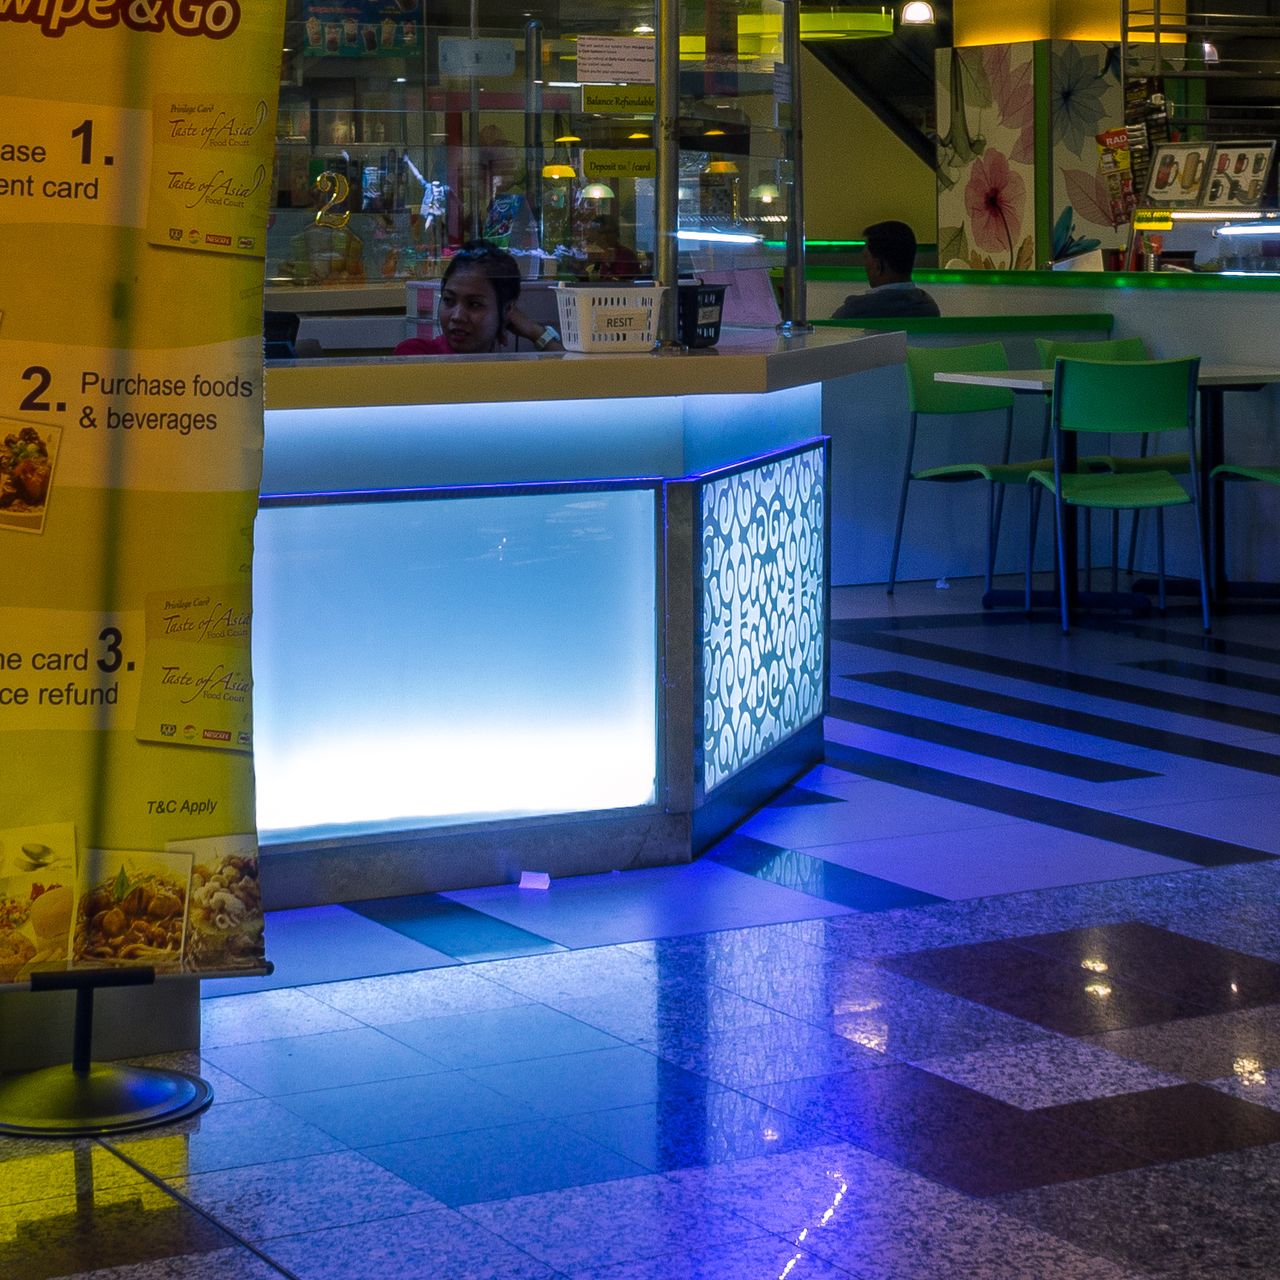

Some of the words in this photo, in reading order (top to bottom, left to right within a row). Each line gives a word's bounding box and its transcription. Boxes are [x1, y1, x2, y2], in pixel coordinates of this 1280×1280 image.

[586, 96, 614, 106] Balance
[615, 96, 655, 109] Refundable
[71, 119, 115, 166] 1.
[169, 119, 198, 138] Taste
[200, 112, 226, 149] of
[215, 118, 254, 137] Asia
[590, 162, 616, 173] Deposit
[42, 177, 99, 200] card
[168, 171, 196, 191] Taste
[185, 170, 225, 208] of
[211, 178, 252, 198] Asia
[316, 171, 351, 228] 2
[606, 317, 633, 328] RESIT
[20, 365, 66, 412] 2.
[80, 371, 186, 396] Purchase
[193, 374, 253, 398] foods
[79, 407, 97, 429] &
[106, 406, 218, 435] beverages
[162, 614, 194, 635] Taste
[197, 603, 222, 643] of
[31, 648, 89, 672] card
[97, 627, 136, 673] 3.
[38, 681, 119, 706] refund
[162, 666, 193, 686] Taste
[180, 664, 224, 704] of
[147, 799, 177, 815] T&C
[180, 798, 218, 818] Apply
